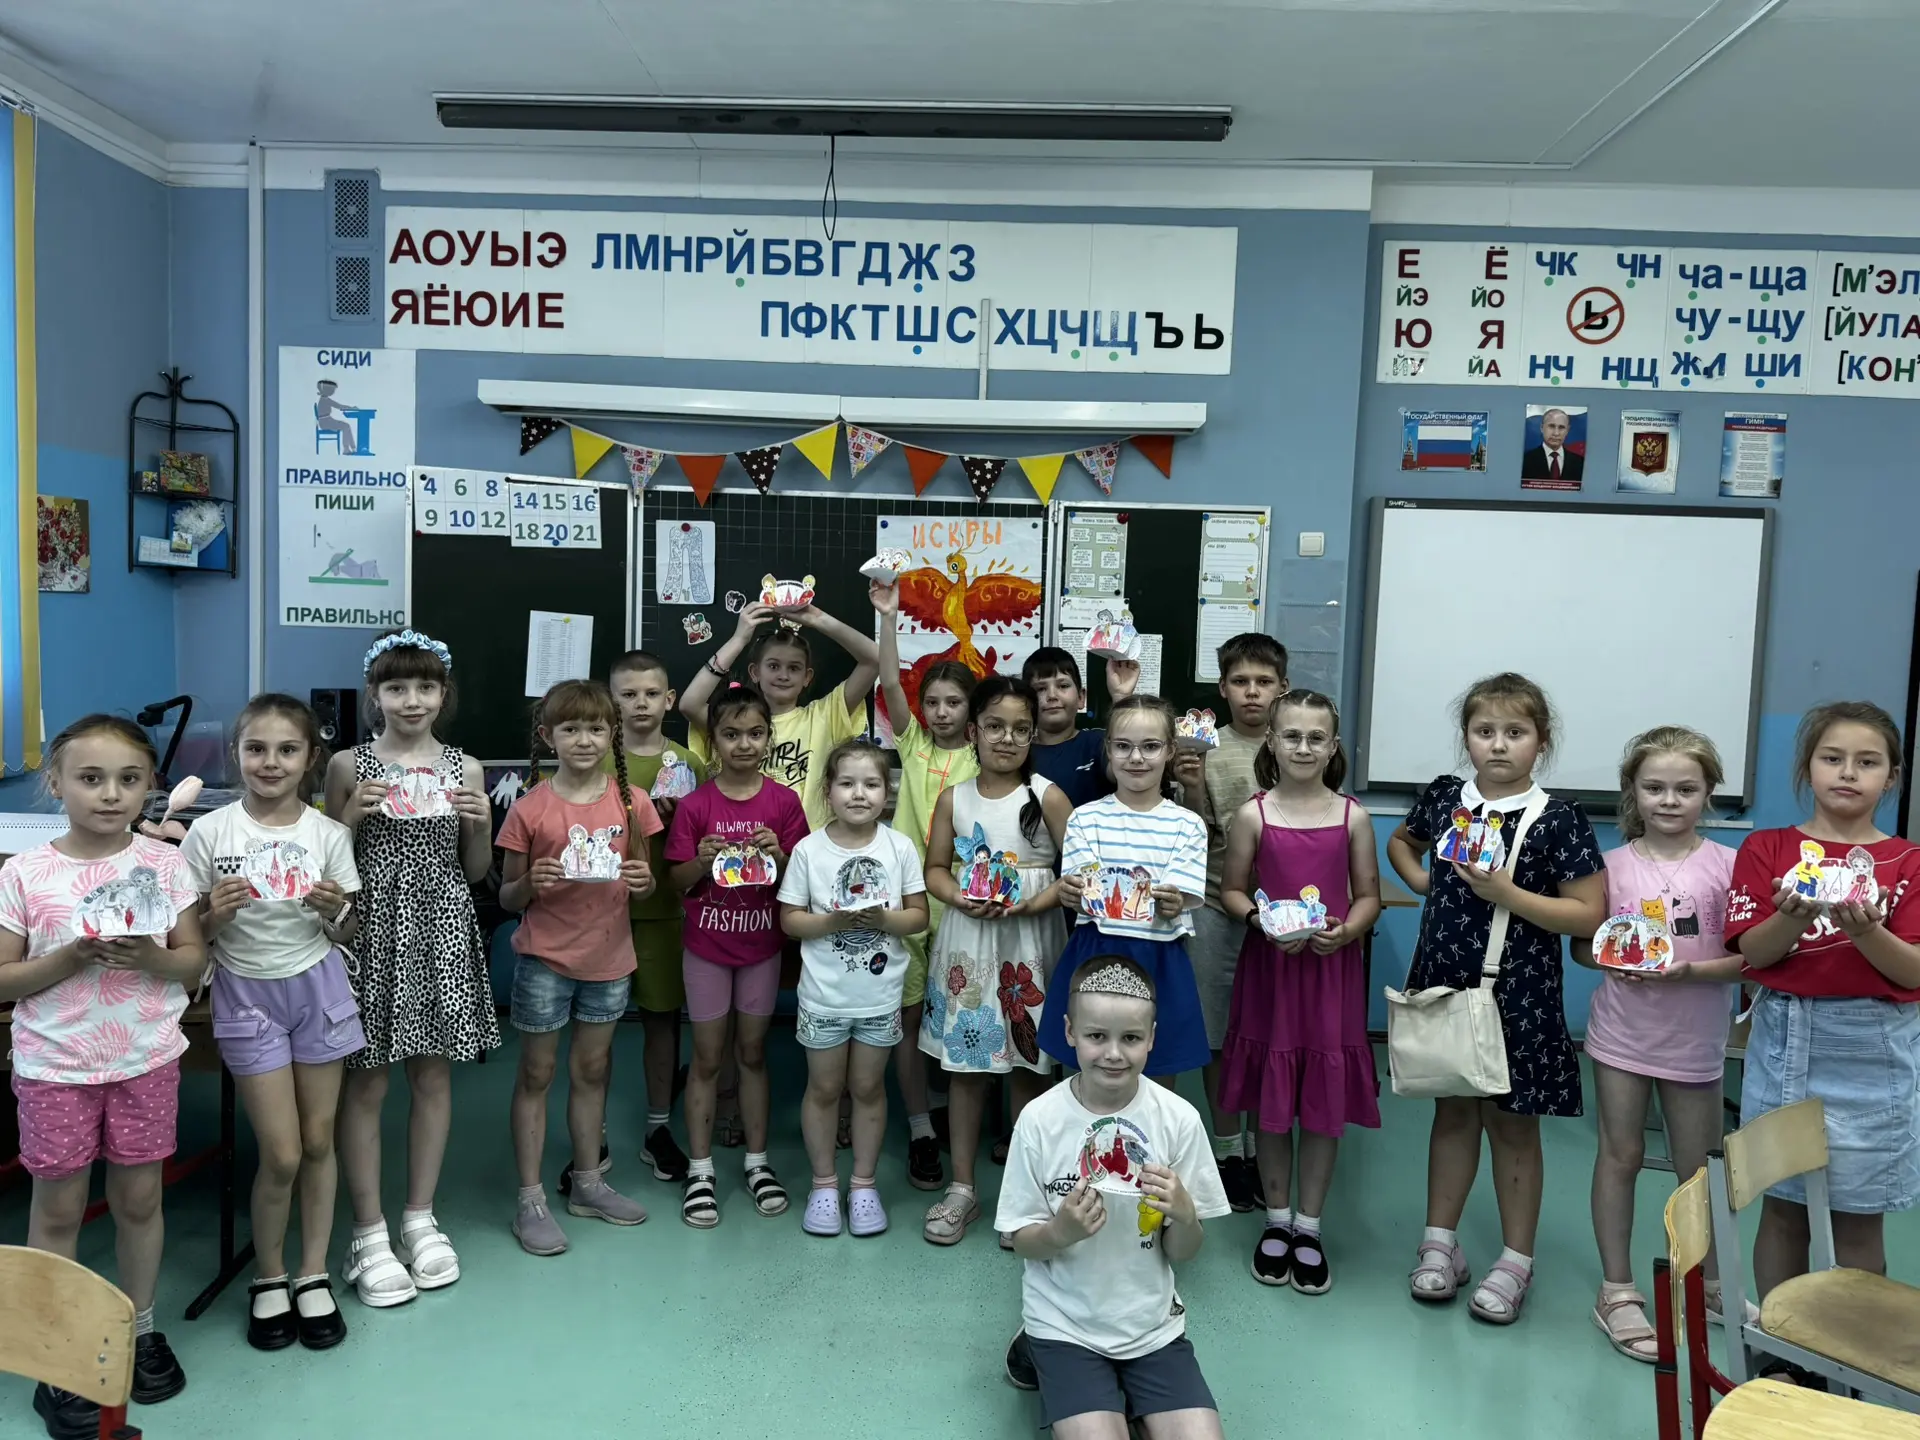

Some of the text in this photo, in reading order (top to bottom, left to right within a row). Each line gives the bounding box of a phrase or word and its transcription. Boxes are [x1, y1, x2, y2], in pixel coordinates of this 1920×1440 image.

[388, 228, 568, 268] АОУЫЭ
[1398, 248, 1420, 279] Е
[1485, 246, 1508, 280] Ё
[388, 283, 566, 329] ЯЁЮИЕ
[1396, 284, 1429, 307] ЙЭ
[1471, 286, 1505, 308] ЙО
[1394, 318, 1432, 348] Ю
[1477, 319, 1505, 349] Я
[317, 349, 372, 369] СИДИ
[1468, 355, 1502, 378] ЙА
[286, 468, 406, 488] ПРАВИЛЬНО
[423, 477, 499, 497] 4 6 8
[315, 494, 374, 511] ПИШИ
[513, 492, 597, 512] 14 15 16
[425, 509, 506, 529] 9 10 12
[514, 522, 597, 542] 18 20 21
[912, 518, 1003, 549] ИСКРЫ
[286, 606, 405, 626] ПРАВИЛЬНО
[716, 821, 752, 833] ALWAYS
[213, 856, 233, 864] HYPE
[698, 905, 773, 933] FASHION
